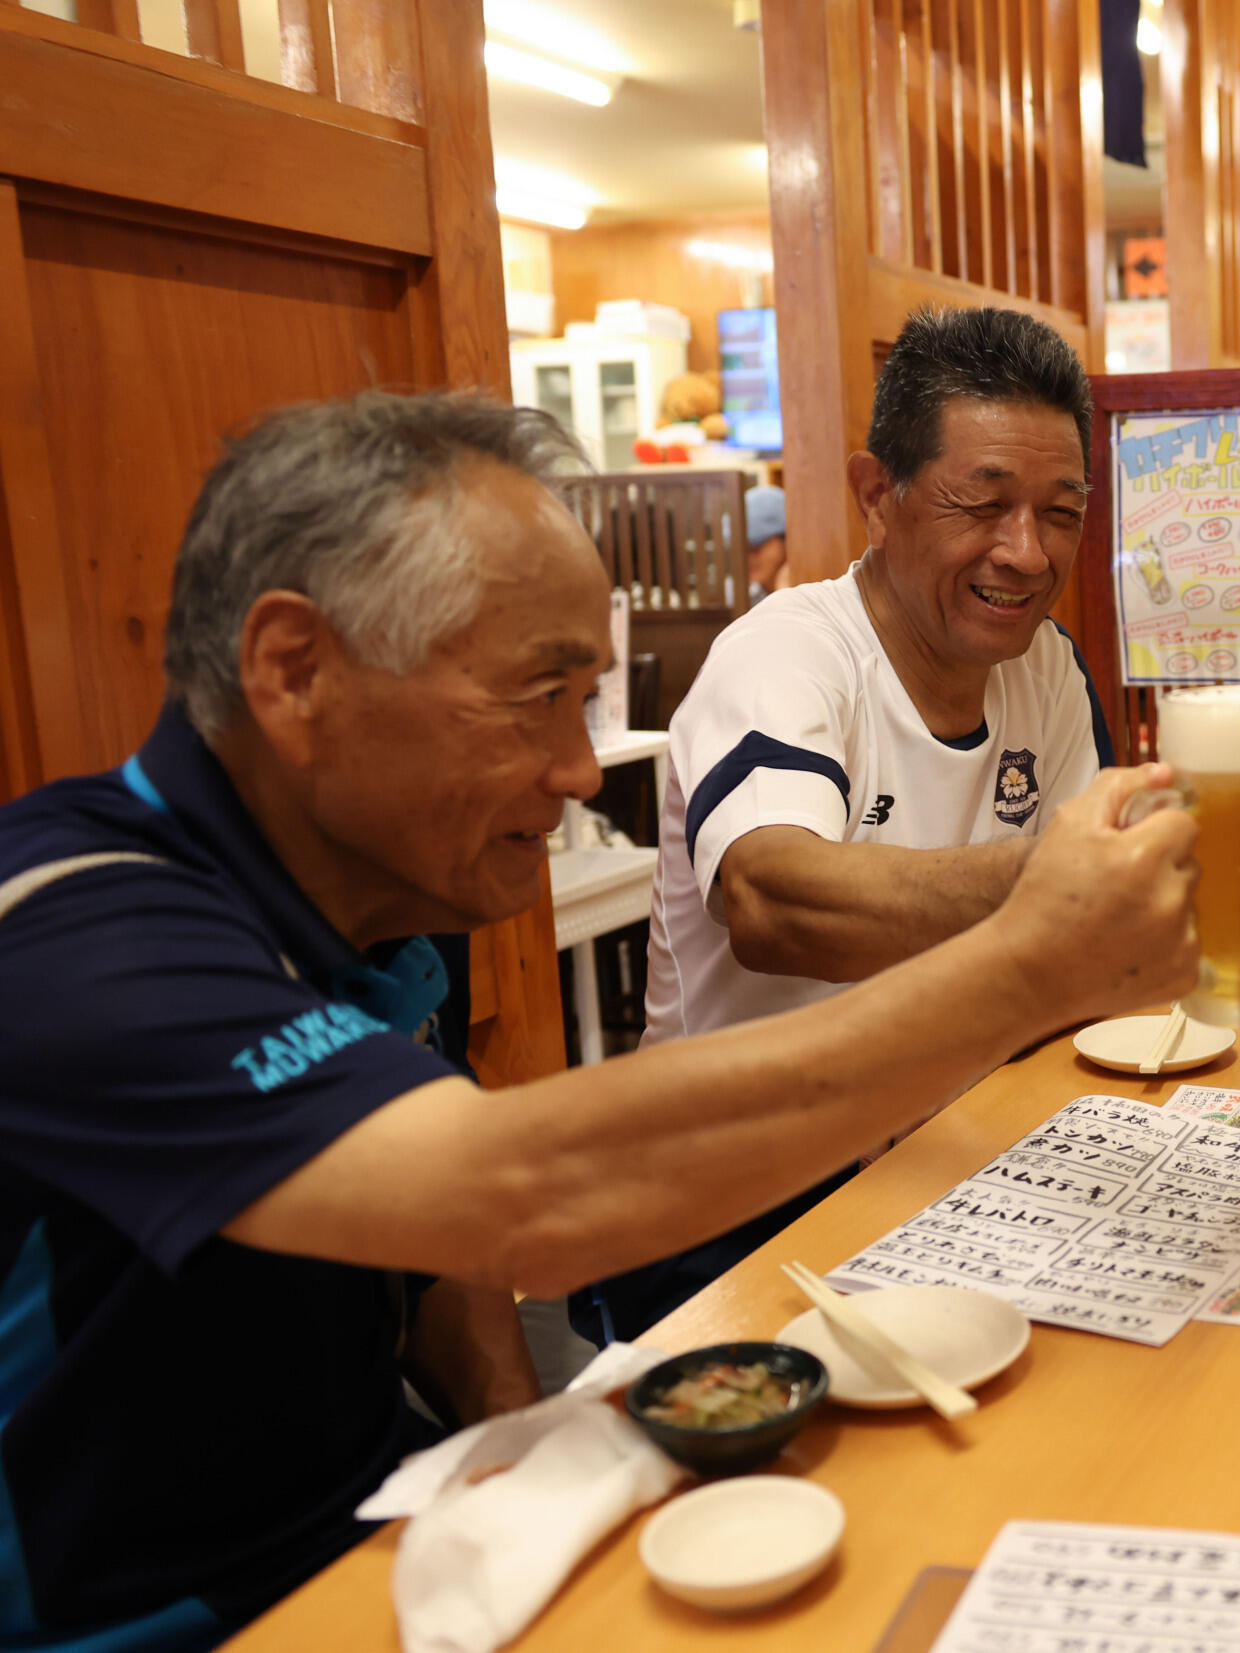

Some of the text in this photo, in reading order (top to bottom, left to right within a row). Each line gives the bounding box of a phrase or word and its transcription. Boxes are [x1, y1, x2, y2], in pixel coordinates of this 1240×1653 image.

[1042, 1124, 1138, 1151] トンカツ
[980, 1164, 1111, 1199] ハムステーキ
[937, 1196, 1058, 1229] 牛レバトロ
